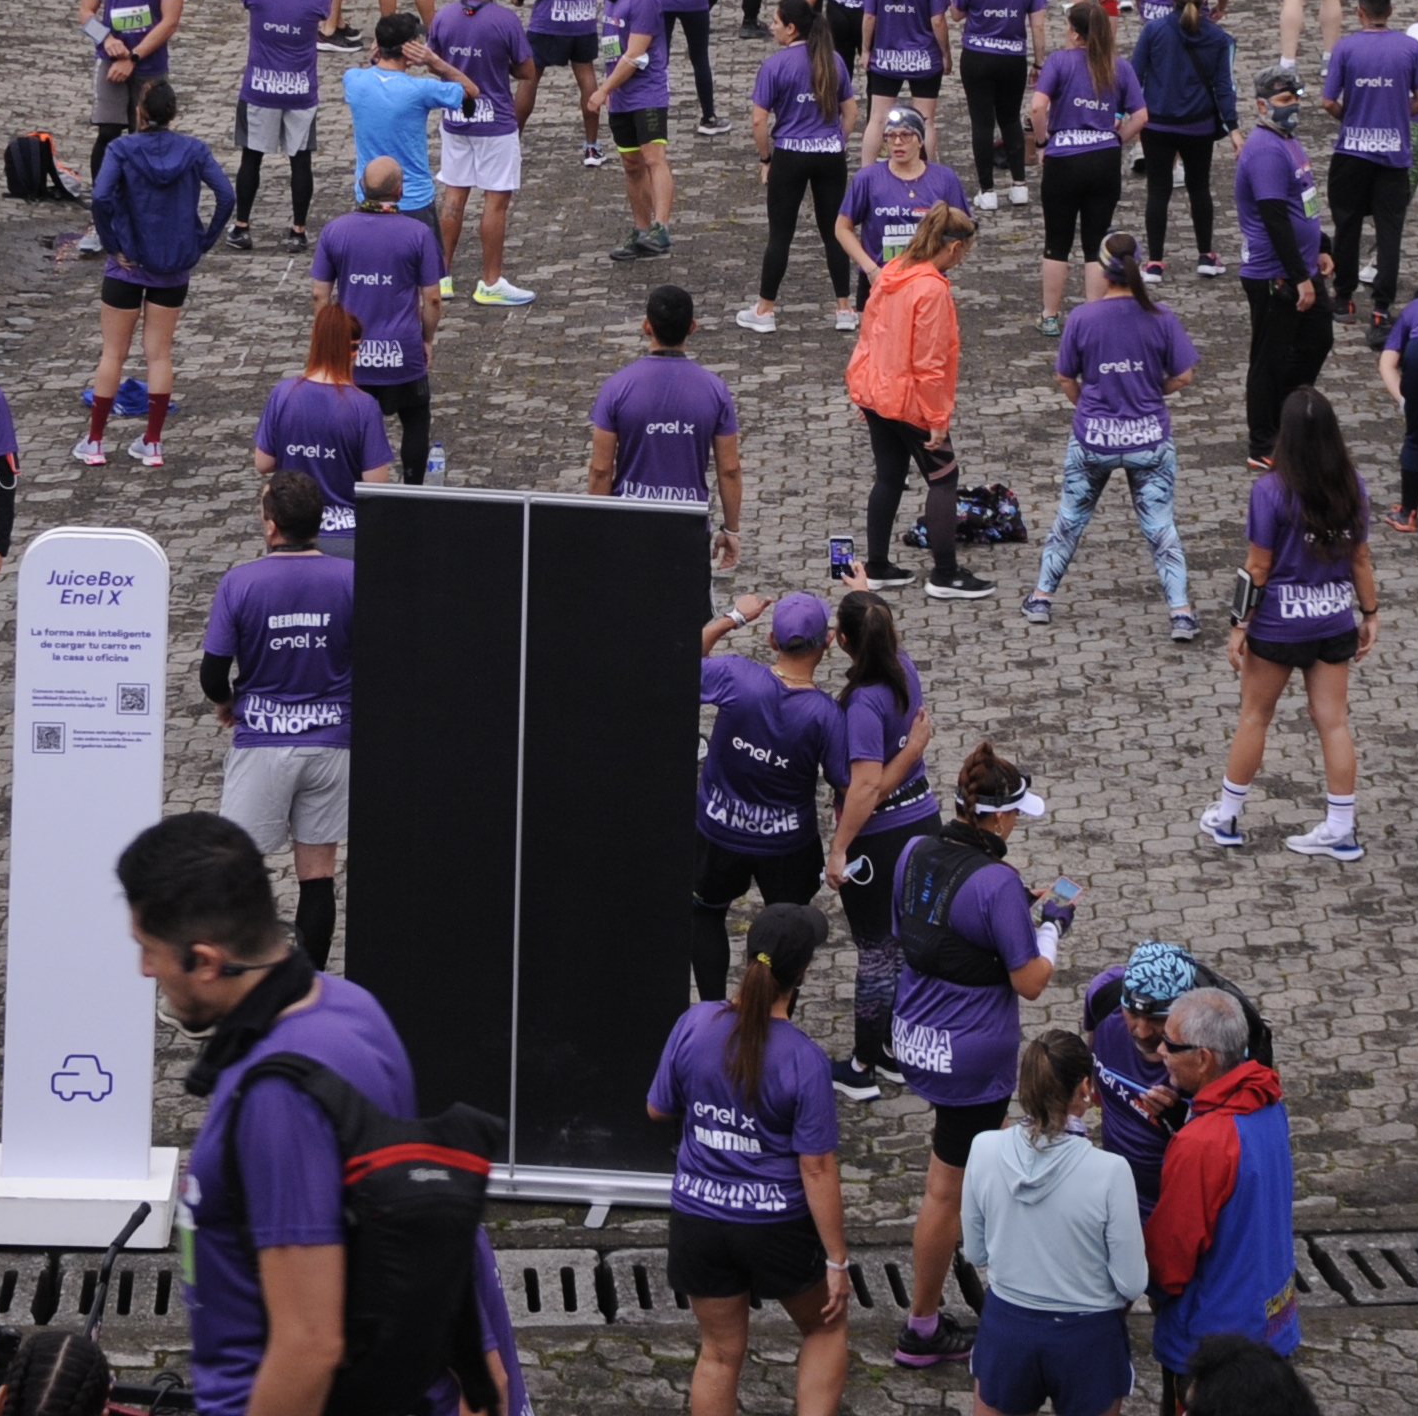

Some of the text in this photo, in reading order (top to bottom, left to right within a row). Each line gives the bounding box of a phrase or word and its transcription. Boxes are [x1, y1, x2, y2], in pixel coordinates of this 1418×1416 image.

[884, 4, 905, 12] enel
[121, 14, 143, 28] 779
[263, 22, 289, 35] enel
[890, 62, 931, 72] NOCHE
[251, 77, 309, 96] LA NOCHE
[1355, 77, 1382, 87] enel
[1074, 97, 1098, 110] enel
[1344, 137, 1401, 153] LA NOCHE
[875, 205, 900, 216] enel
[350, 273, 378, 286] enel
[1099, 359, 1130, 374] enel
[647, 421, 679, 434] enel
[1088, 415, 1162, 437] ILUMINA
[1085, 427, 1162, 446] LA NOCHE
[287, 445, 320, 457] enel
[47, 570, 135, 587] JuiceBox
[60, 589, 122, 605] Enel X
[268, 614, 331, 629] GERMAN F
[98, 629, 151, 639] inteligente
[270, 633, 310, 650] enel
[41, 640, 52, 648] de
[55, 642, 85, 650] cargar
[95, 654, 129, 662] oficina
[272, 715, 341, 734] NOCHE
[732, 737, 771, 762] enel
[706, 800, 799, 835] LA NOCHE
[694, 1102, 736, 1126] enel
[694, 1125, 761, 1153] MARTINA
